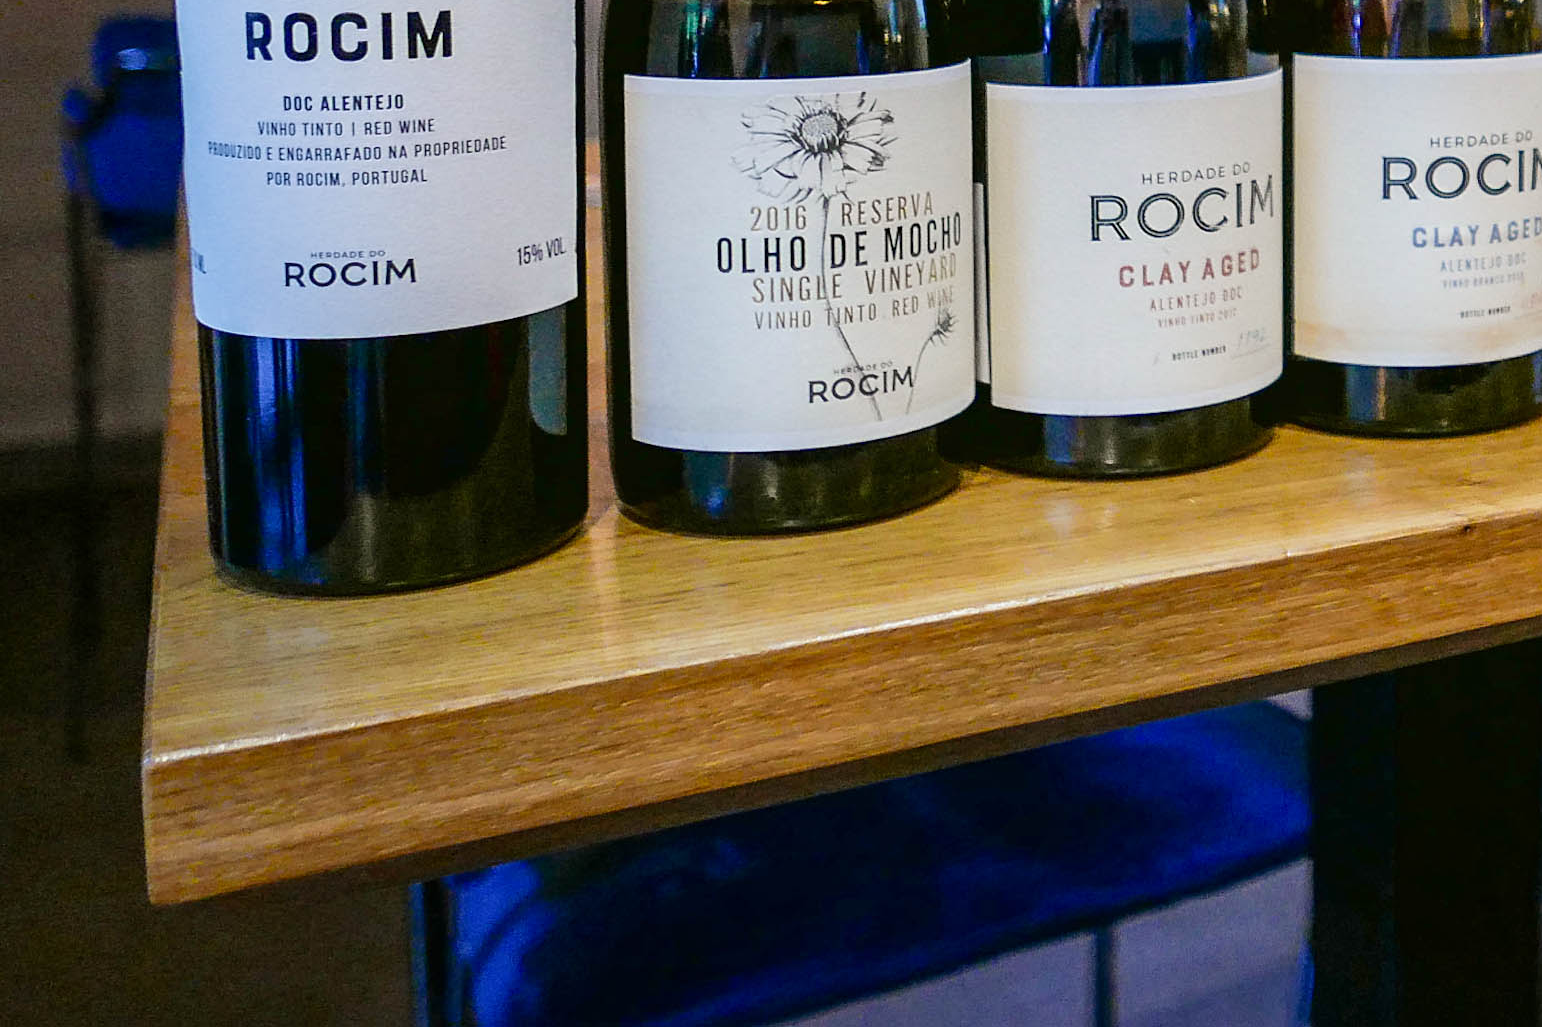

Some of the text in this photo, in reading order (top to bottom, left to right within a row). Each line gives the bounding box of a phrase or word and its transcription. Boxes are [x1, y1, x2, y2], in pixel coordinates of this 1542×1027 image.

[245, 10, 453, 62] ROCIM
[283, 94, 404, 111] DOC ALENTEJO
[257, 119, 435, 136] VINHO TINTO RED WINE
[1430, 130, 1533, 148] HERDADE DO
[208, 136, 507, 162] PRODUZIDO E ENGARRAFADO NA PROPRIEDADE
[266, 169, 428, 187] POR ROCIM, PORTUGAL
[1142, 162, 1250, 185] HERDADE DO
[750, 192, 934, 231] 2016 RESERVA
[1090, 174, 1274, 241] ROCIM
[717, 212, 961, 273] OLHO DE MOCHO
[1412, 216, 1542, 248] CLAY AGED
[311, 250, 386, 259] HERDADE DO
[517, 243, 543, 266] 15%
[1119, 248, 1260, 287] CLAY AGED
[1440, 256, 1502, 272] ALENTEJO
[284, 258, 416, 287] ROCIM
[752, 252, 957, 303] SINGLE VINEYARD
[755, 285, 953, 330] VINHO TINTO RED WINE
[1150, 286, 1242, 311] ALENTEJO DOC
[1158, 316, 1186, 328] VINHO
[1191, 312, 1215, 324] TINTO
[808, 365, 914, 403] ROCIM
